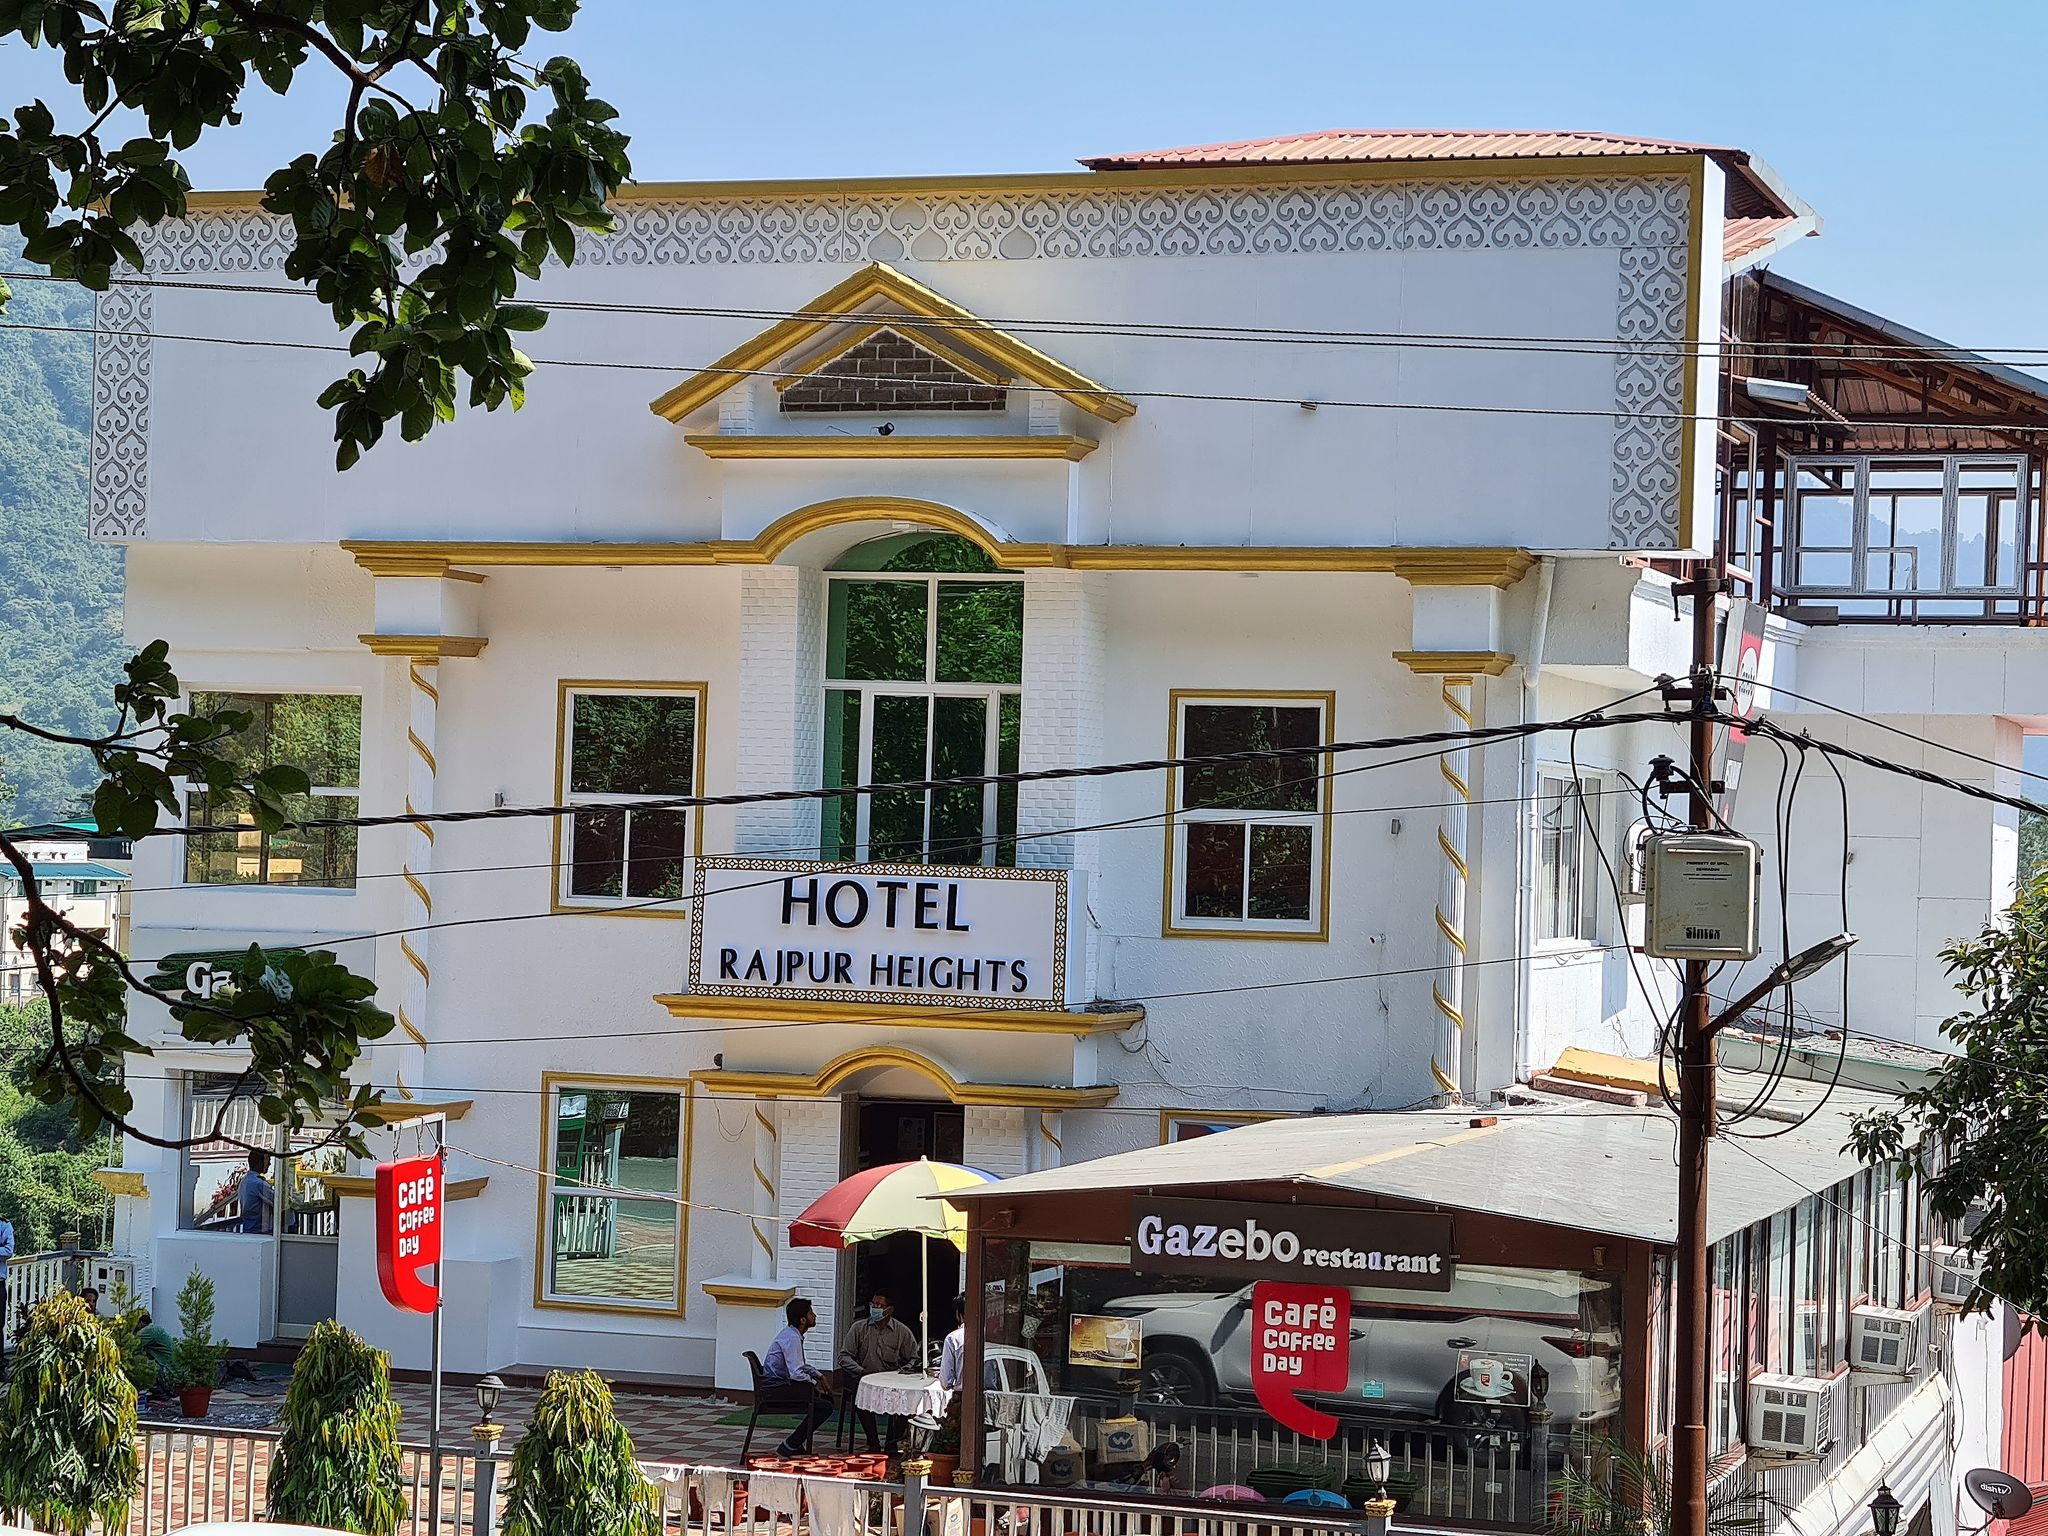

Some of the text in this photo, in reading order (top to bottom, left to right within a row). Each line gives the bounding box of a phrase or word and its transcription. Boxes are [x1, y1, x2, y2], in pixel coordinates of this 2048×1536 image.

[781, 878, 970, 932] HOTEL
[720, 948, 1029, 993] RAJPUR HEIGHTS
[398, 1167, 434, 1209] Café
[398, 1206, 435, 1234] Coffee
[399, 1234, 420, 1258] Day
[1137, 1214, 1441, 1275] Gazebo restaurant
[1264, 1298, 1337, 1329] Café
[1263, 1329, 1336, 1351] Coffee
[1263, 1353, 1303, 1376] Day
